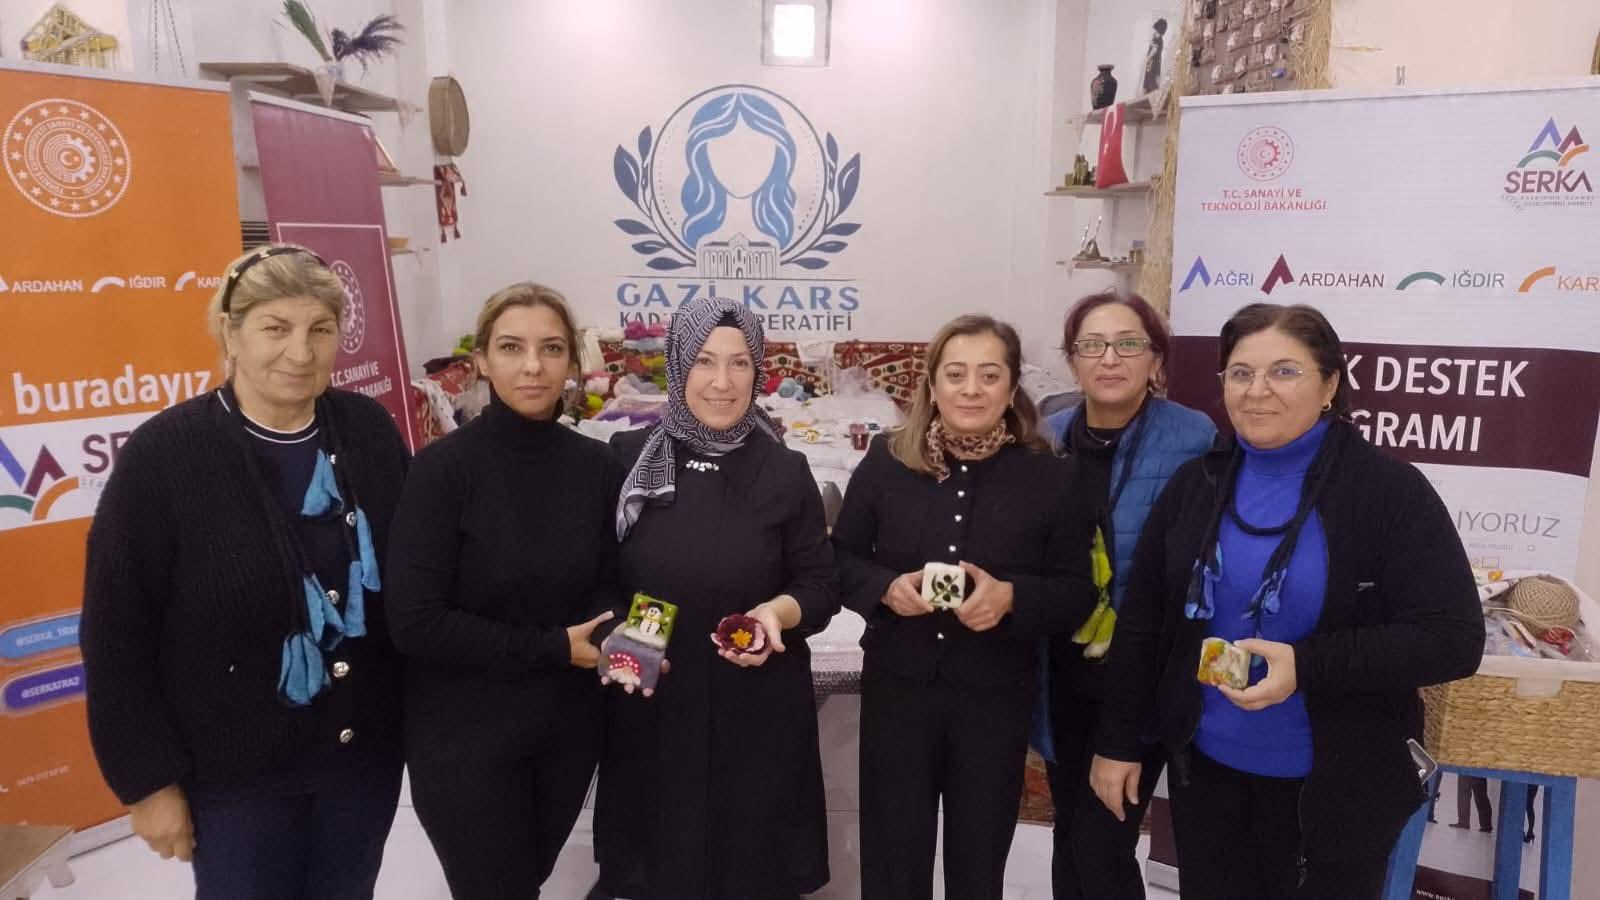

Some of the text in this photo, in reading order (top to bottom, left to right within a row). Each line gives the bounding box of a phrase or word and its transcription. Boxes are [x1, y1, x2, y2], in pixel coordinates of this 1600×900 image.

[1287, 188, 1303, 198] VE
[1503, 169, 1593, 193] SERKA
[12, 280, 83, 293] ARDAHAN
[129, 276, 166, 289] IĞDIR
[1214, 269, 1600, 291] AĞRI ARDAHAN IĞDIR KAR
[617, 281, 859, 311] GAZİ KARS
[757, 311, 852, 331] PERATİFİ
[1375, 356, 1529, 398] DESTEK
[12, 364, 212, 415] buradayız
[1350, 409, 1482, 452] GRAMI
